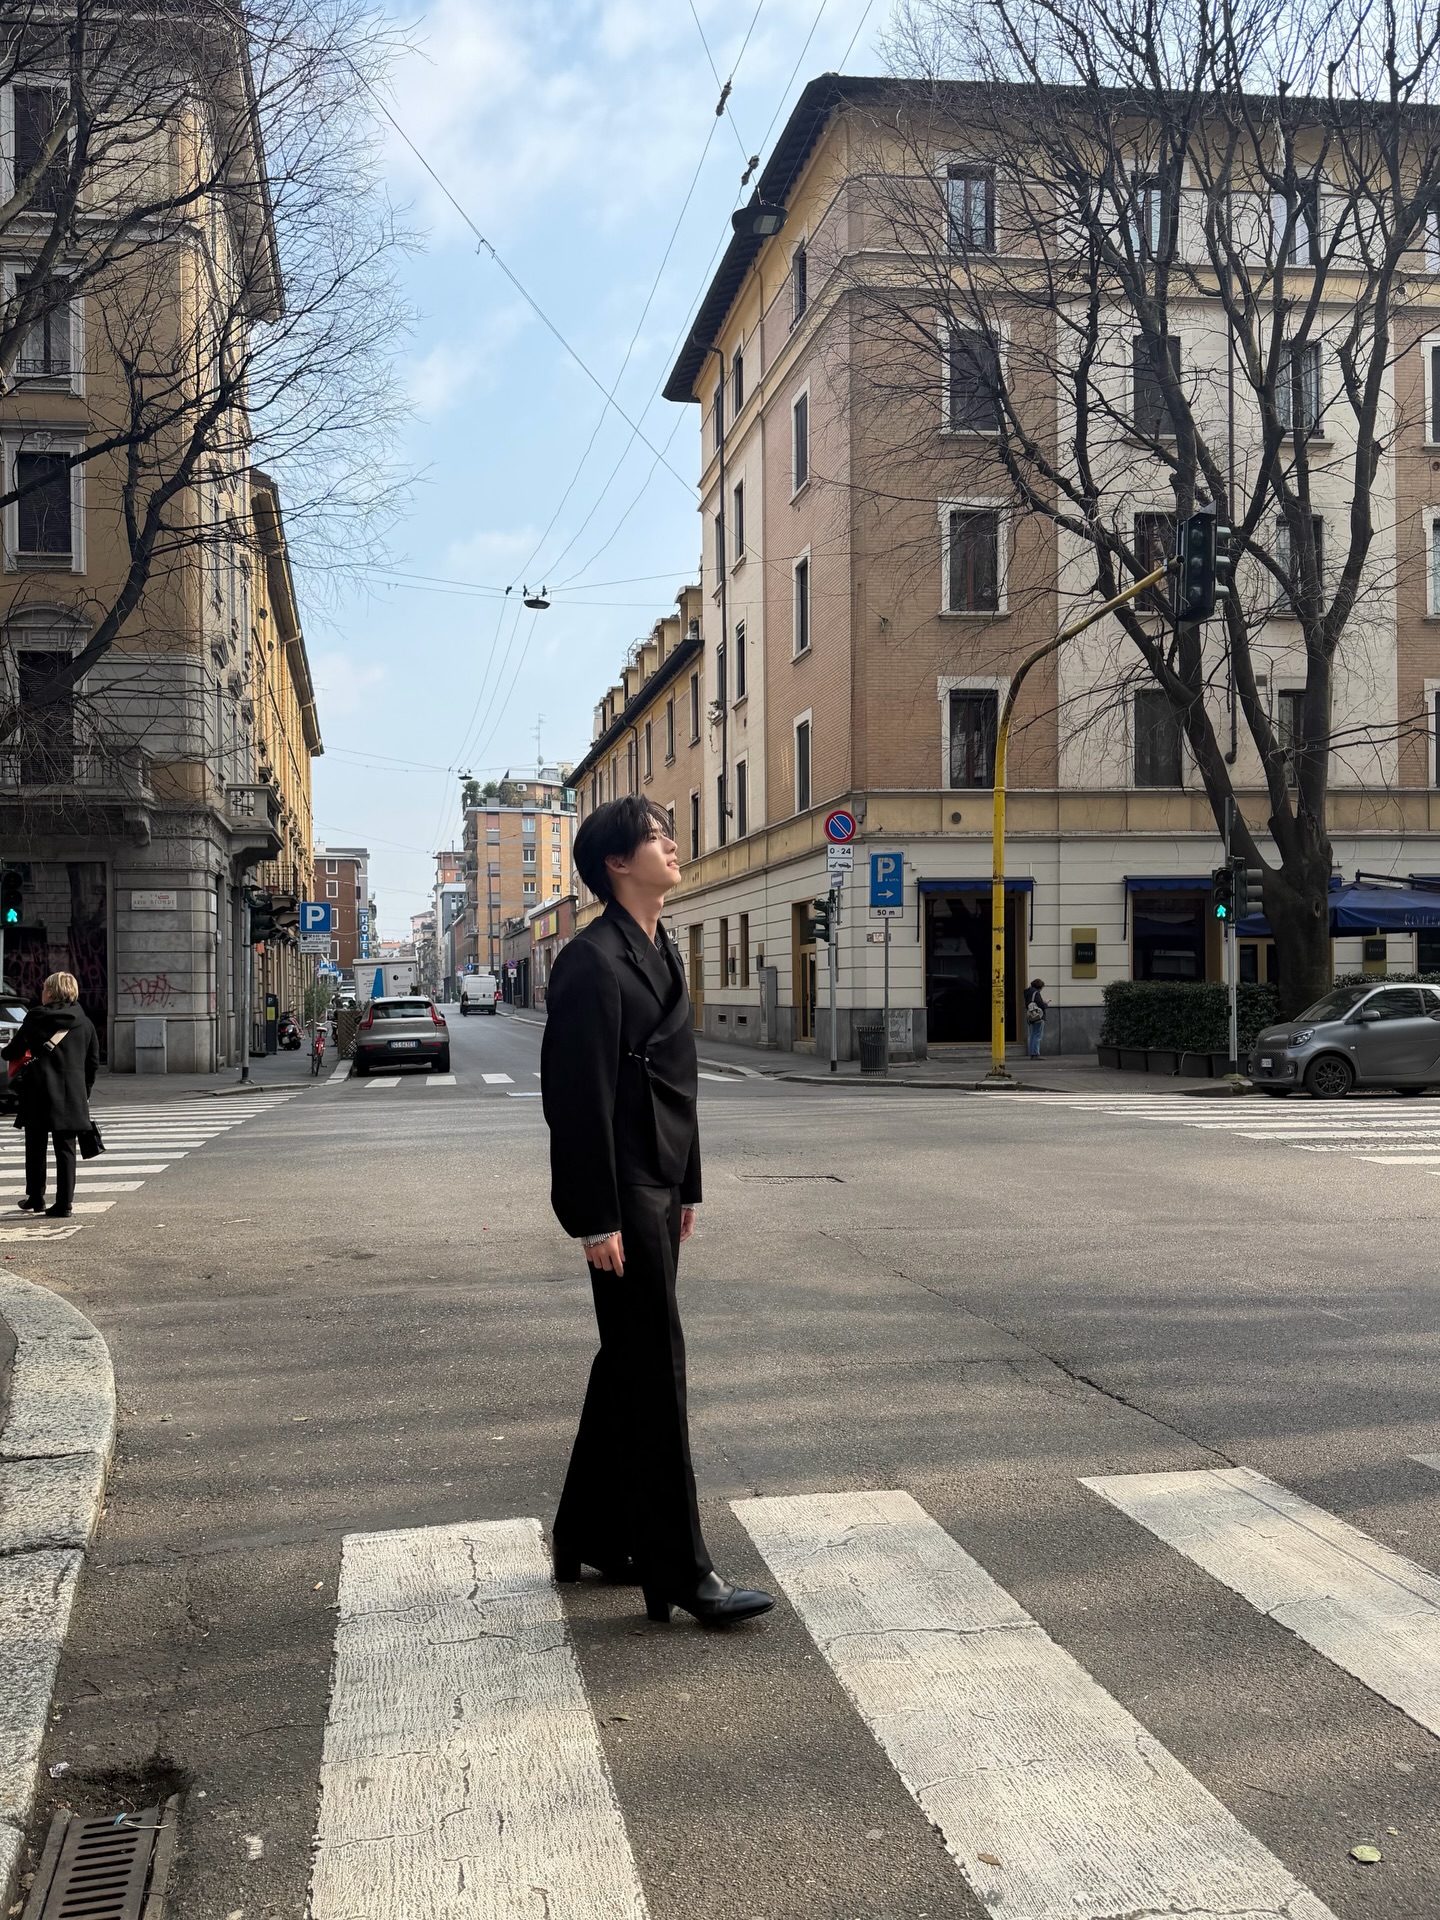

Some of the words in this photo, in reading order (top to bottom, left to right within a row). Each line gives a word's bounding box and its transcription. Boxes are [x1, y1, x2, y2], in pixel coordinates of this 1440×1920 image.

[829, 847, 835, 855] 0
[841, 847, 851, 855] 24
[877, 857, 896, 883] P
[306, 905, 325, 930] P
[361, 915, 369, 959] HOTEL
